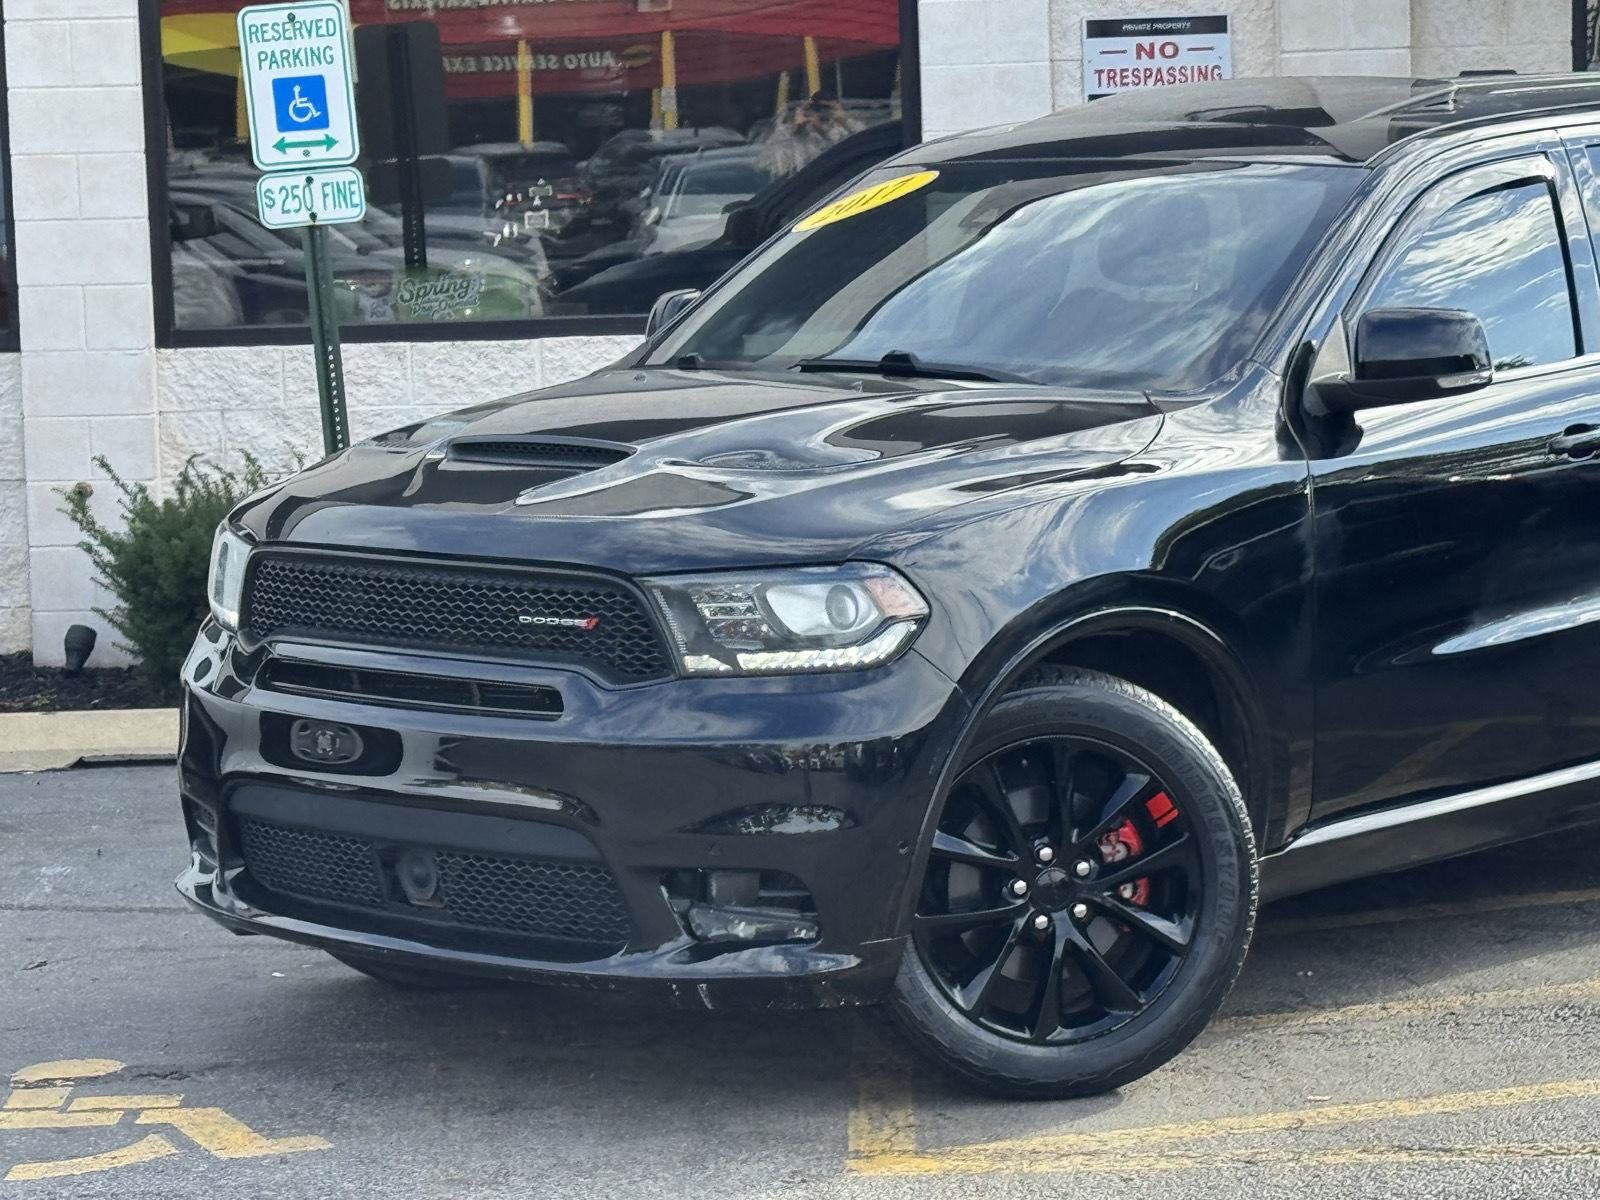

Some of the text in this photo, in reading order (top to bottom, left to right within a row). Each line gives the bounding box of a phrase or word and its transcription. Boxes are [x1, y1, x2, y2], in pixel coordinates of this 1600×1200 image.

[248, 17, 337, 43] RESERVED
[257, 45, 335, 71] PARKING
[1135, 41, 1180, 60] NO
[1094, 64, 1222, 88] TRESPASSING
[263, 180, 360, 214] $250 FINE
[398, 276, 472, 304] Spring
[518, 615, 589, 628] DODGE
